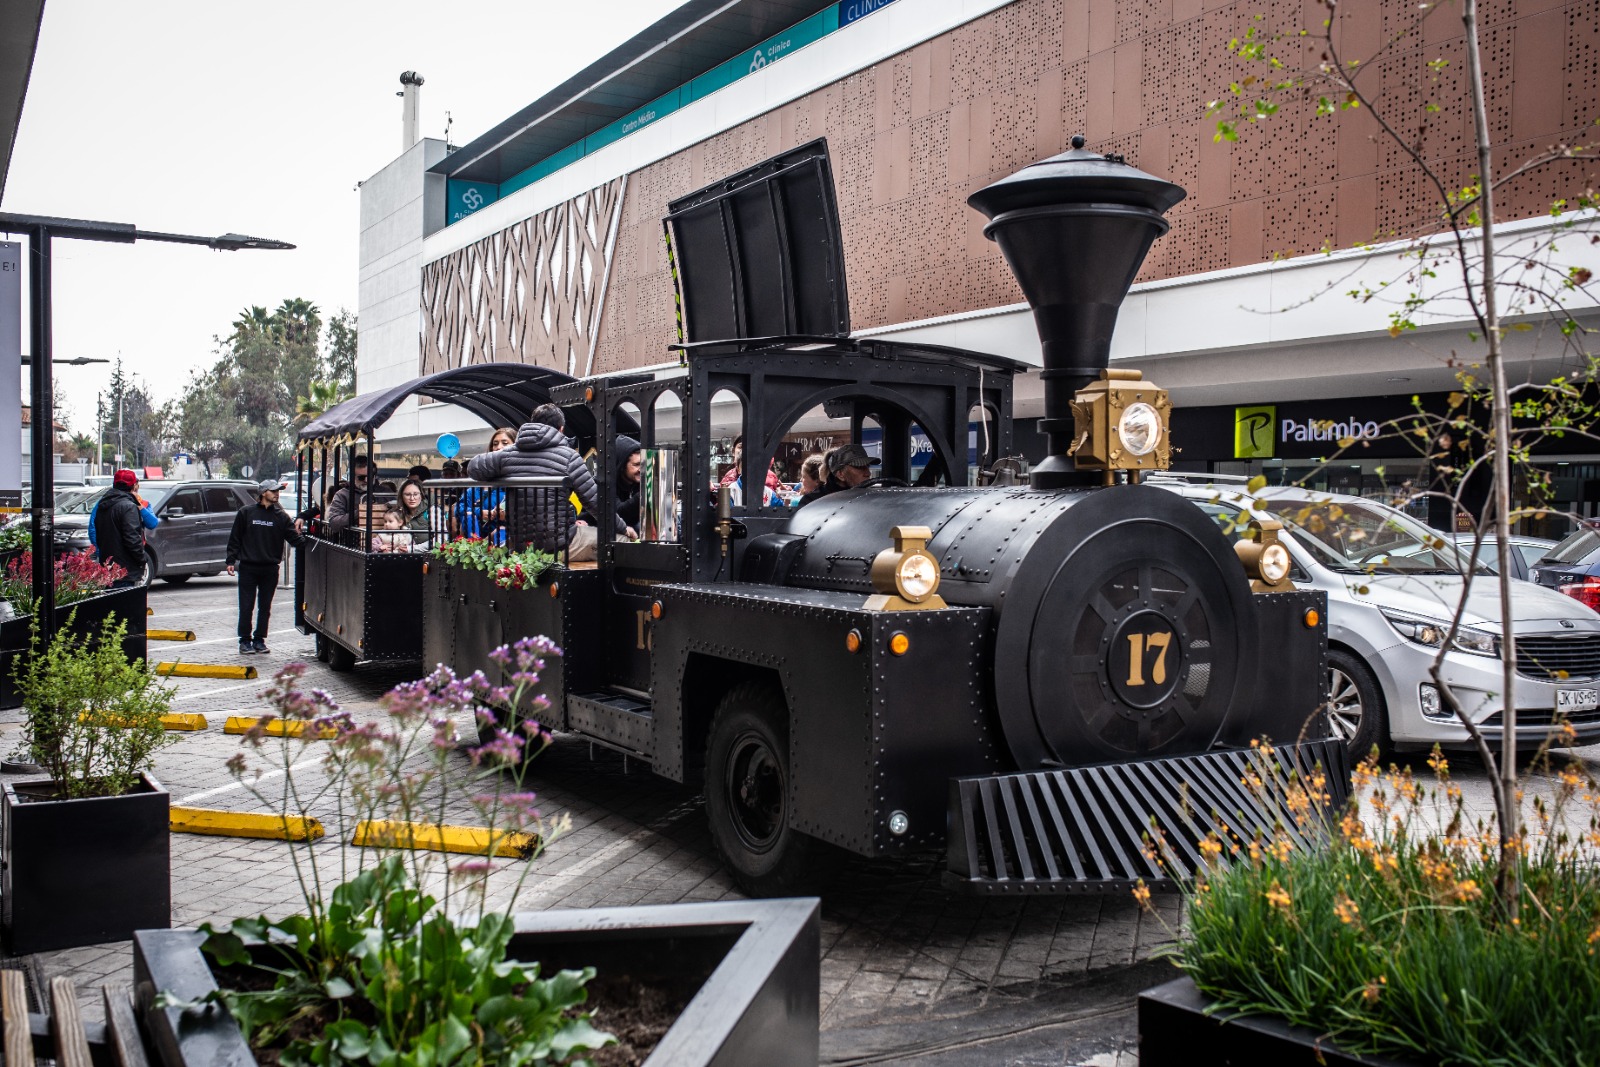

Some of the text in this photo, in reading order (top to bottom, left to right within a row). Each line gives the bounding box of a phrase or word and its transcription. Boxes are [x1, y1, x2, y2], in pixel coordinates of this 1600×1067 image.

[1281, 416, 1381, 443] Palumbo
[917, 439, 935, 453] Kra
[1126, 631, 1172, 686] 17
